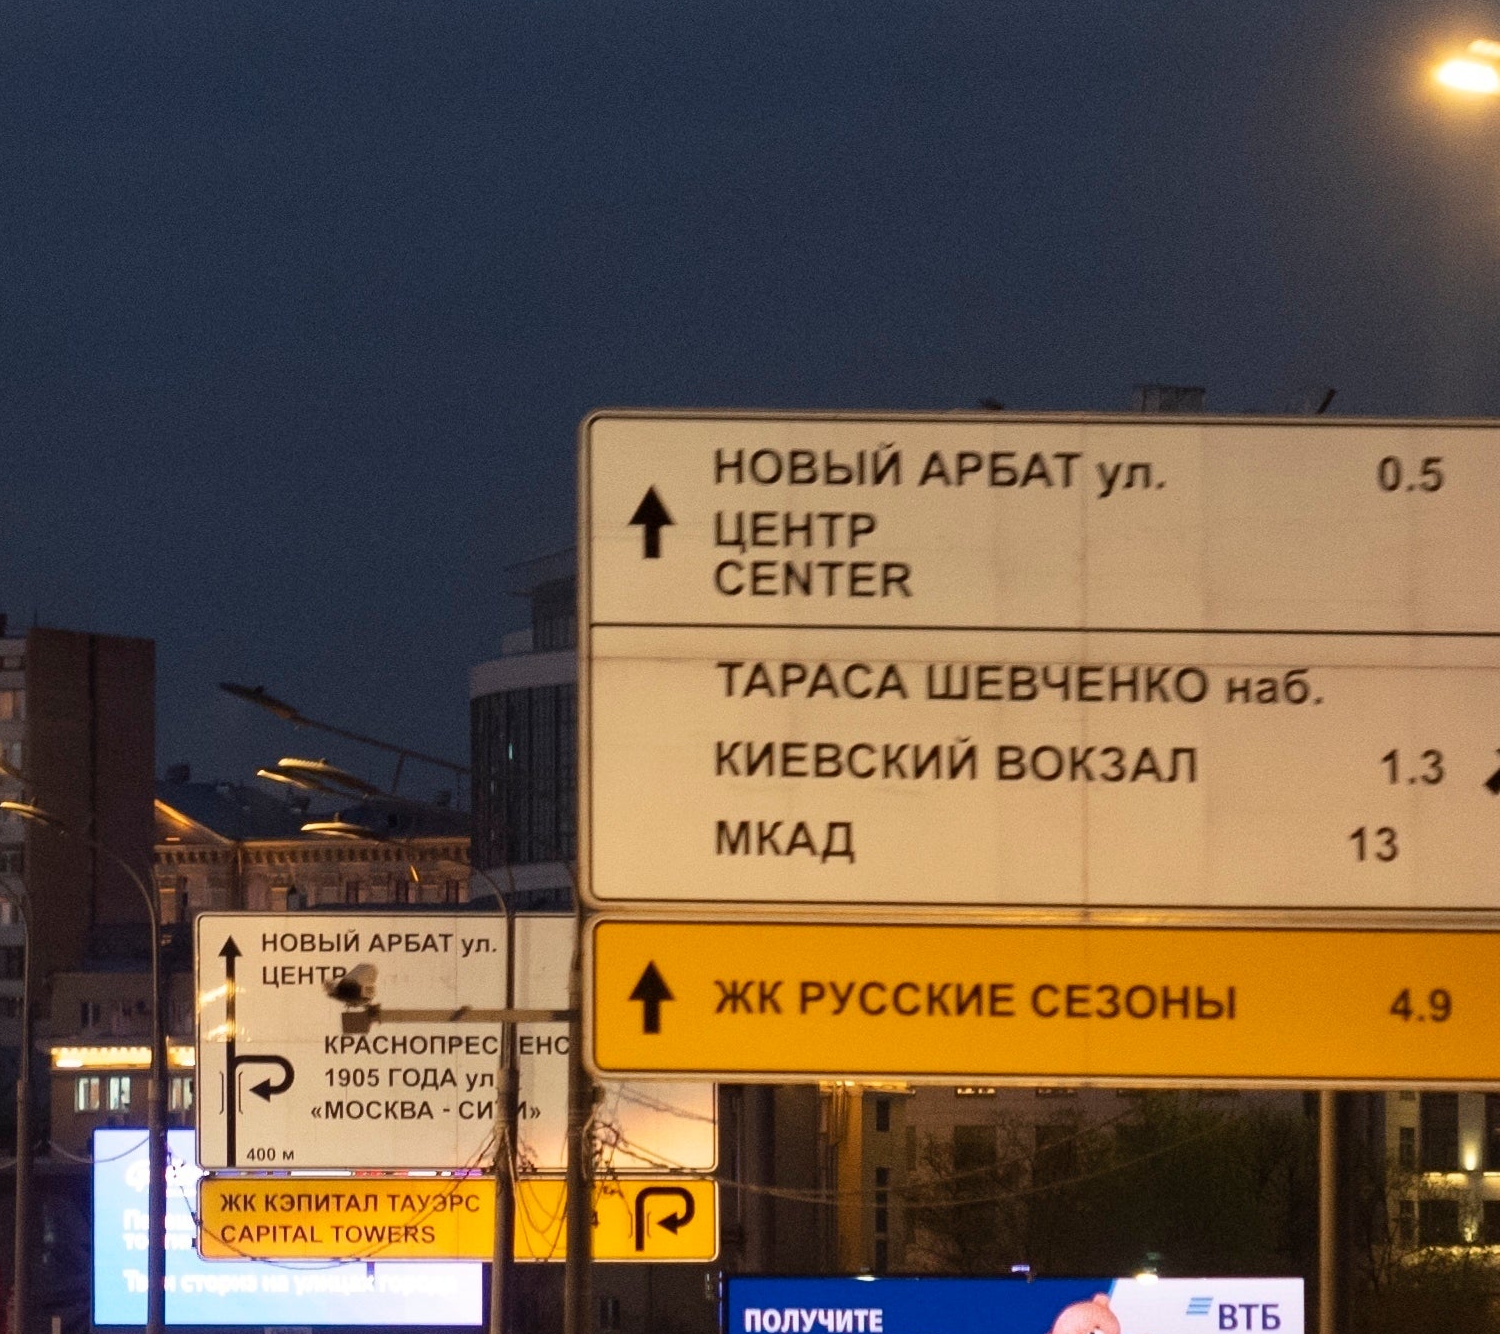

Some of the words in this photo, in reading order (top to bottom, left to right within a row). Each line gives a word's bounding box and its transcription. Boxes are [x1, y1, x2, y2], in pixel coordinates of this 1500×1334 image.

[714, 443, 902, 487] НОВЫЙ
[918, 451, 1082, 489] АРБАТ
[1097, 461, 1165, 499] ул.
[1377, 455, 1444, 494] 0.5
[714, 511, 877, 552] ЦЕНТР
[713, 559, 912, 598] CENTER
[715, 661, 908, 700] ТАРАСА
[926, 664, 1209, 705] ШЕВЧЕНКО
[1226, 667, 1324, 706] наб.
[715, 736, 978, 781] КИЕВСКИЙ
[996, 745, 1197, 784] ВОКЗАЛ
[1381, 748, 1445, 786] 1.3
[715, 819, 856, 865] МКАД
[1348, 825, 1400, 864] 13
[261, 929, 361, 953] НОВЫЙ
[367, 932, 454, 954] АРБАТ
[460, 937, 498, 958] ул.
[713, 979, 783, 1015] ЖК
[799, 980, 1015, 1018] РУССКИЕ
[1030, 982, 1237, 1021] СЕЗОНЫ
[1388, 987, 1454, 1024] 4.9
[324, 1033, 570, 1056] КРАСНОПРЕСЕНС
[325, 1067, 381, 1088] 1905
[387, 1067, 459, 1091] ГОДА
[310, 1099, 435, 1121] «МОСКВА
[457, 1099, 542, 1121] СИИ»
[245, 1146, 277, 1162] 400
[219, 1192, 257, 1213] ЖК
[263, 1192, 379, 1213] КЭПИТАЛ
[389, 1193, 482, 1214] ТАУЭРС
[219, 1223, 324, 1245] CAPITAL
[332, 1223, 437, 1245] TOWERS
[743, 1307, 884, 1334] ПОЛУЧИТЕ
[1217, 1302, 1282, 1332] ВТБ
